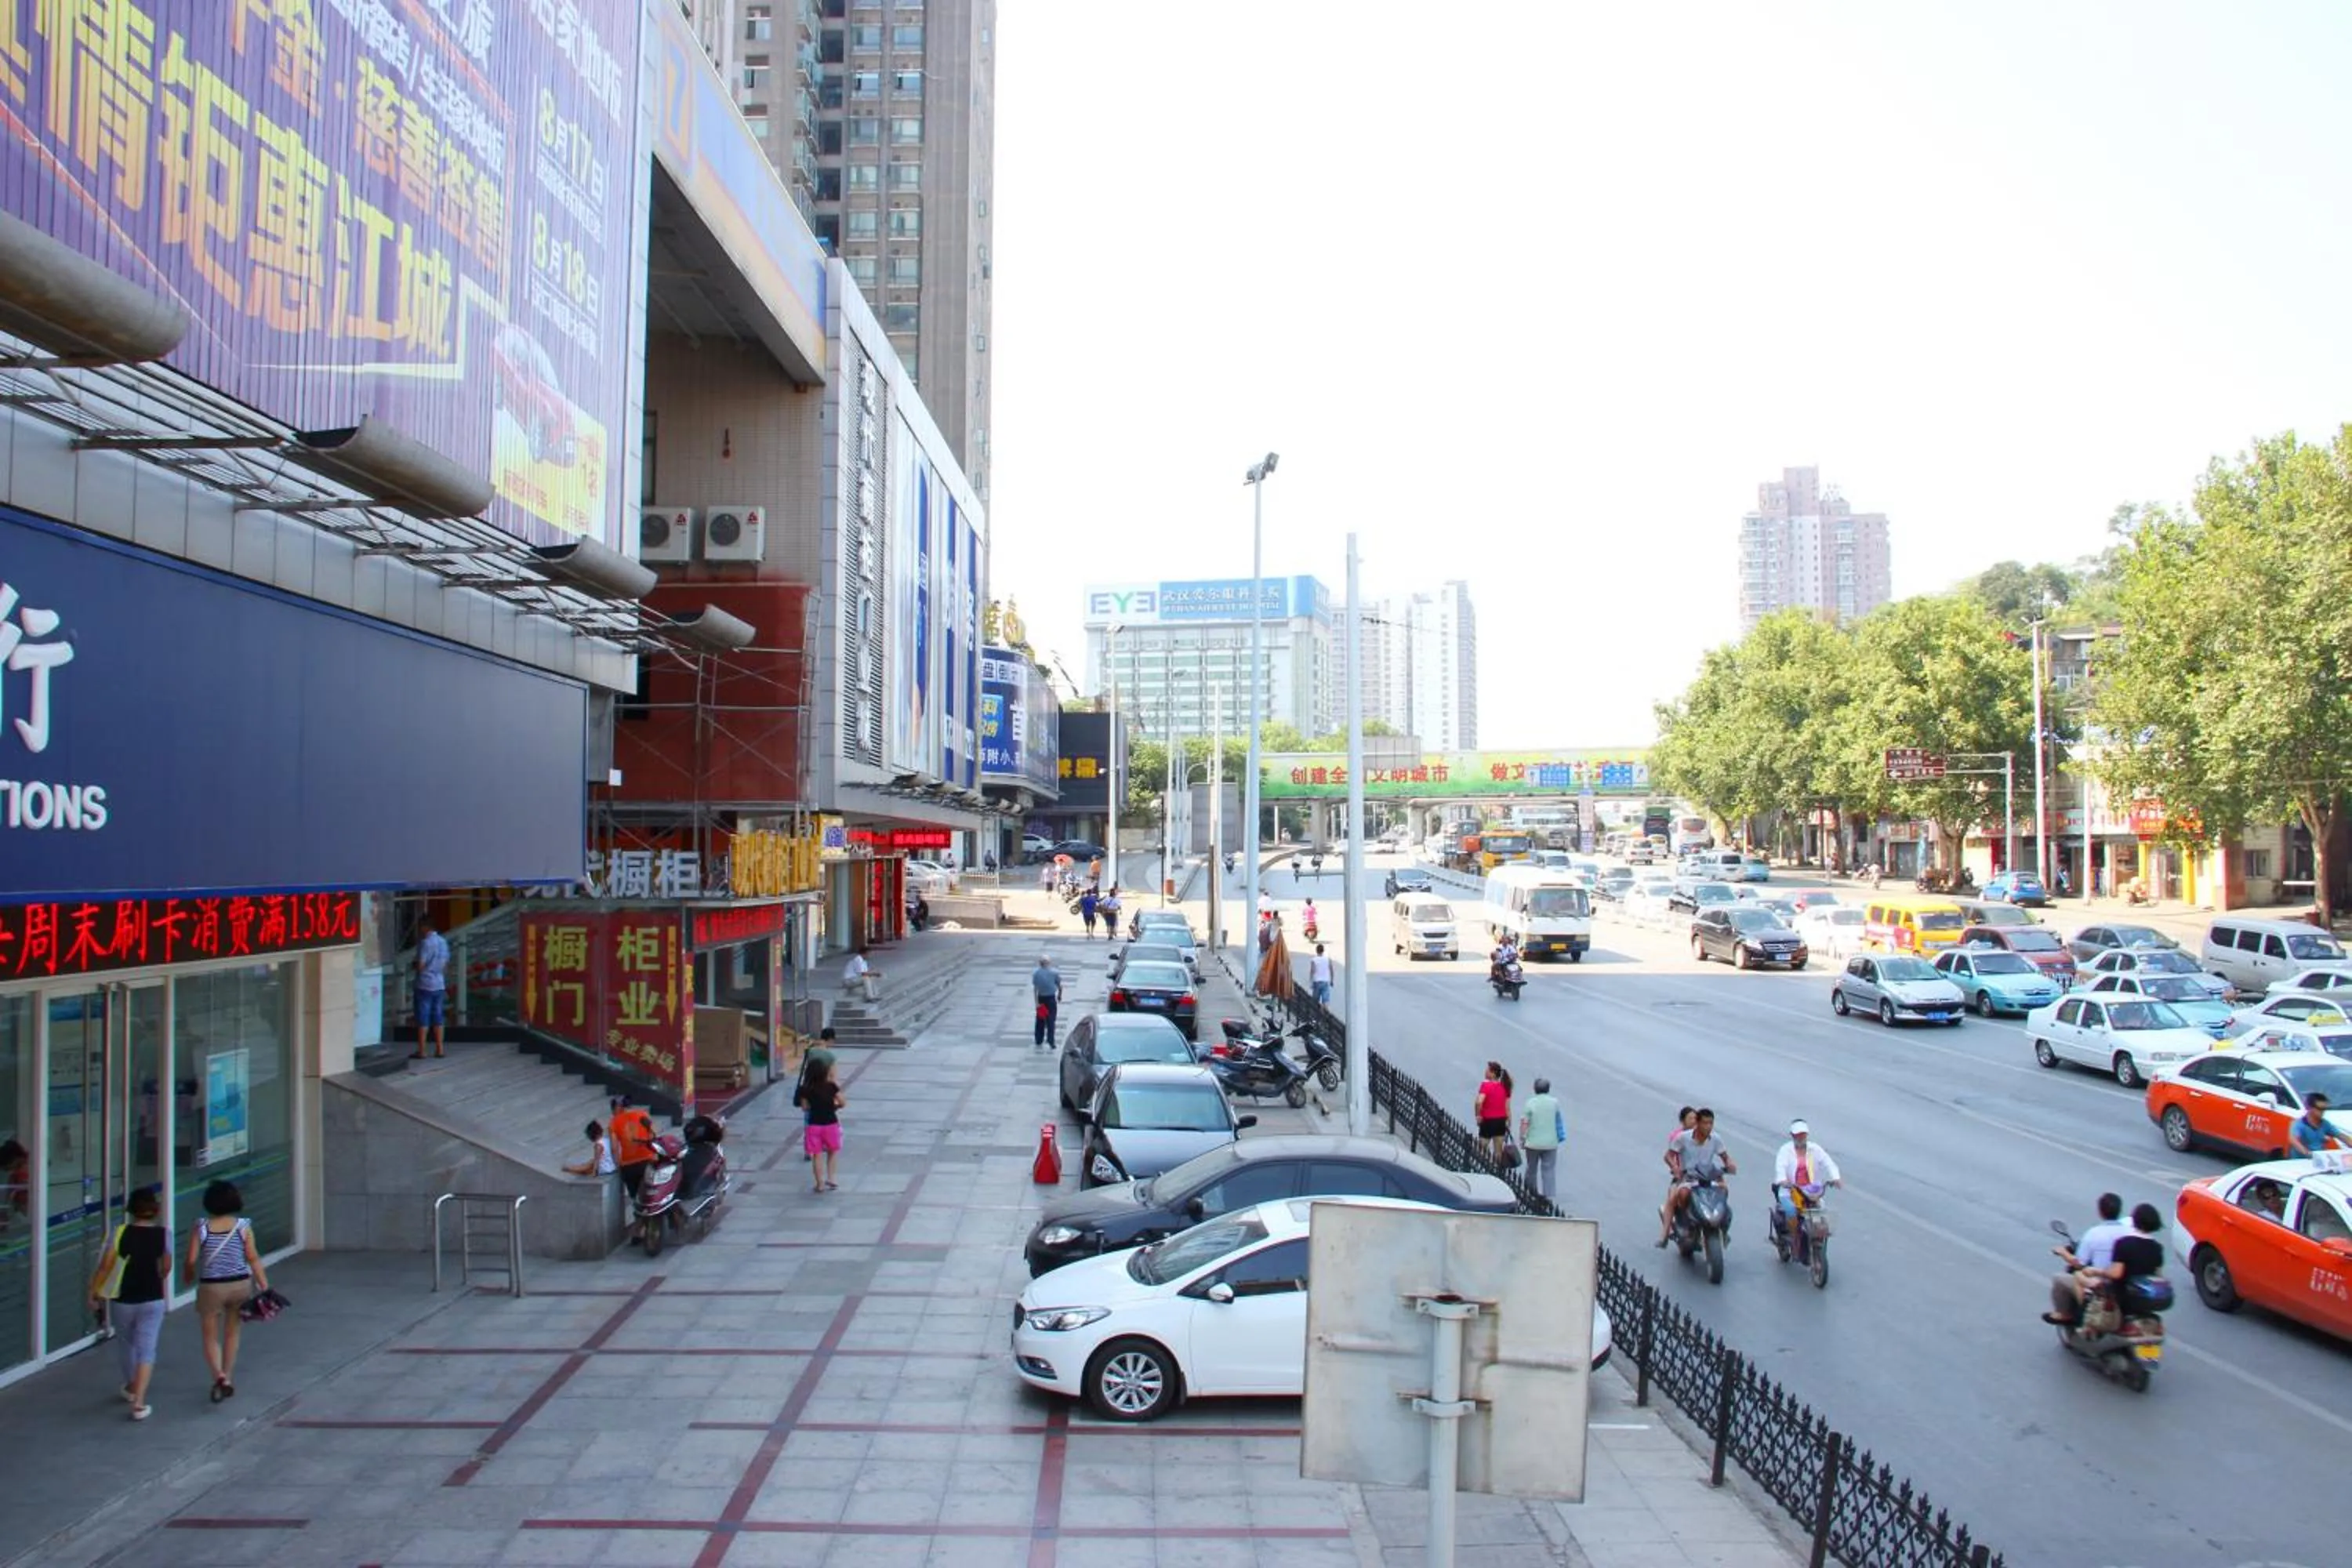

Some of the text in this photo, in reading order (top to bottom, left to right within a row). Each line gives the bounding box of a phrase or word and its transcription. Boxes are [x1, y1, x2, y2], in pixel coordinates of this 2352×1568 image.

[1290, 764, 1450, 785] 创建全文明城市
